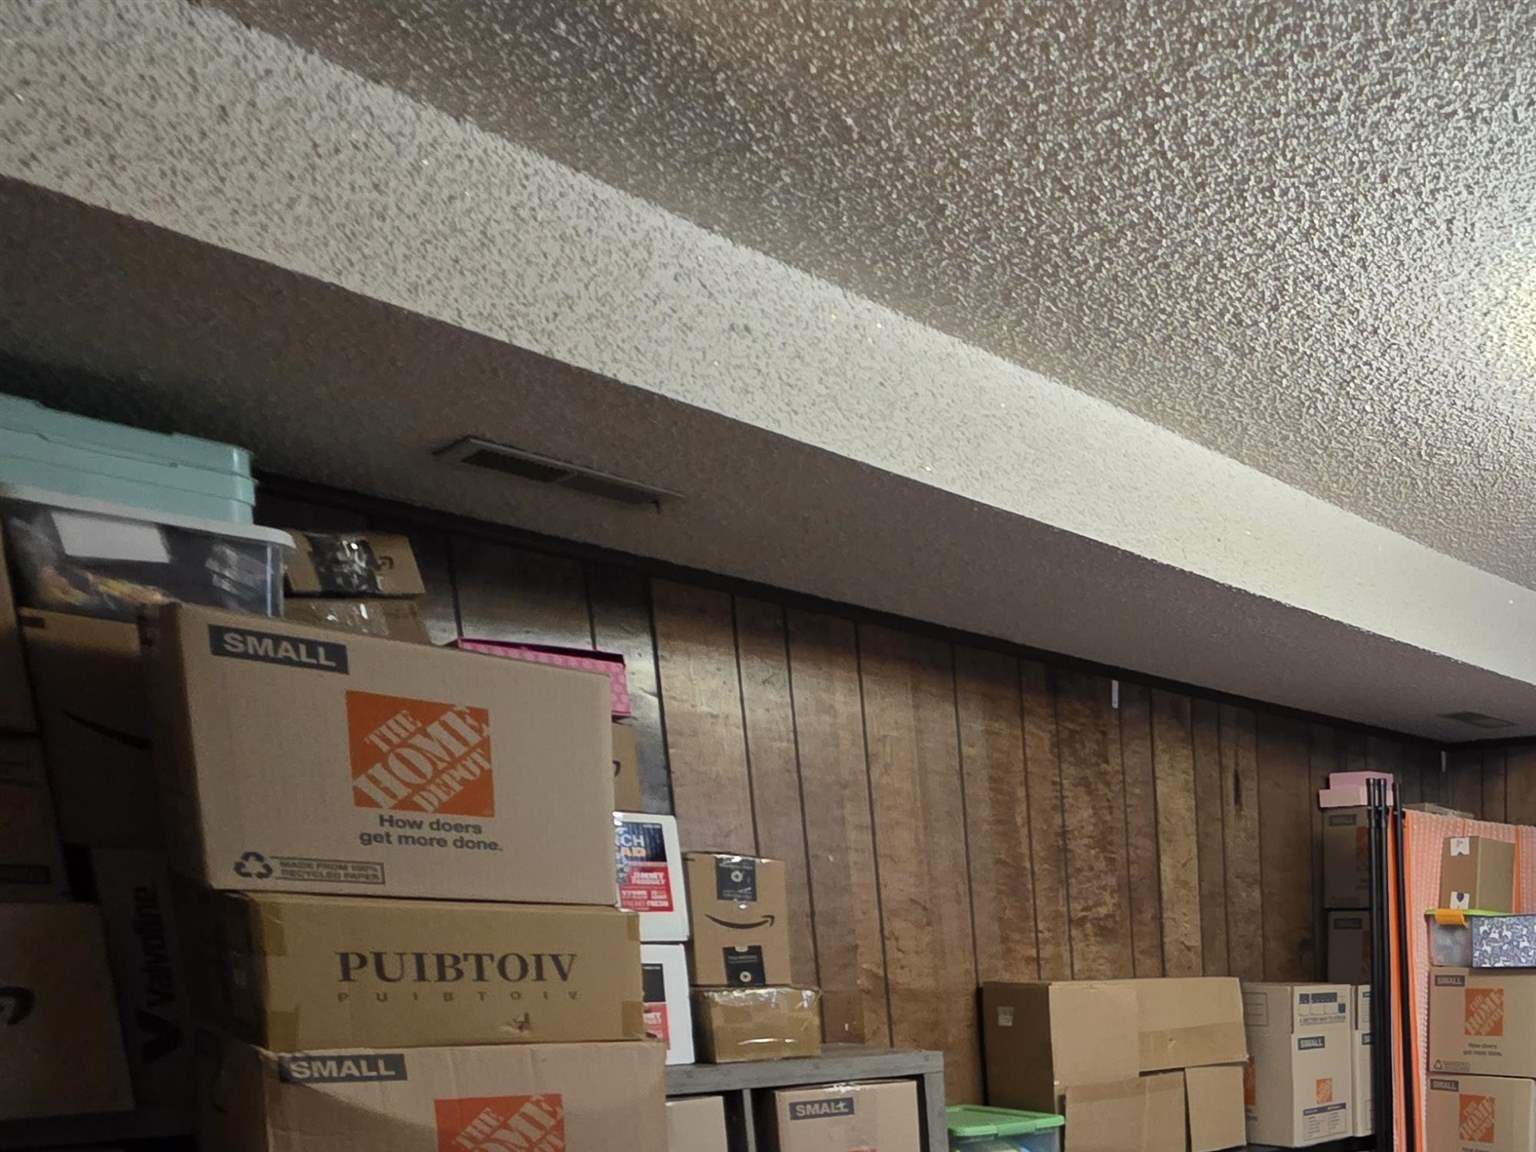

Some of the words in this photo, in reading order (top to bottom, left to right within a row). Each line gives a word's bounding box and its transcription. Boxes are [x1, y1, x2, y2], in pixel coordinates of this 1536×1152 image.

[224, 632, 336, 667] SMALL
[364, 710, 422, 754] THE
[351, 706, 490, 809] HOME
[412, 749, 492, 814] DEPOT
[379, 814, 423, 832] How
[429, 818, 483, 835] doers
[359, 831, 392, 848] get
[398, 833, 447, 849] more
[453, 836, 503, 852] done.
[334, 951, 577, 982] PUIBTOIV
[290, 1059, 396, 1079] SMALL
[796, 1101, 849, 1117] SMALL
[453, 1107, 502, 1150] THE
